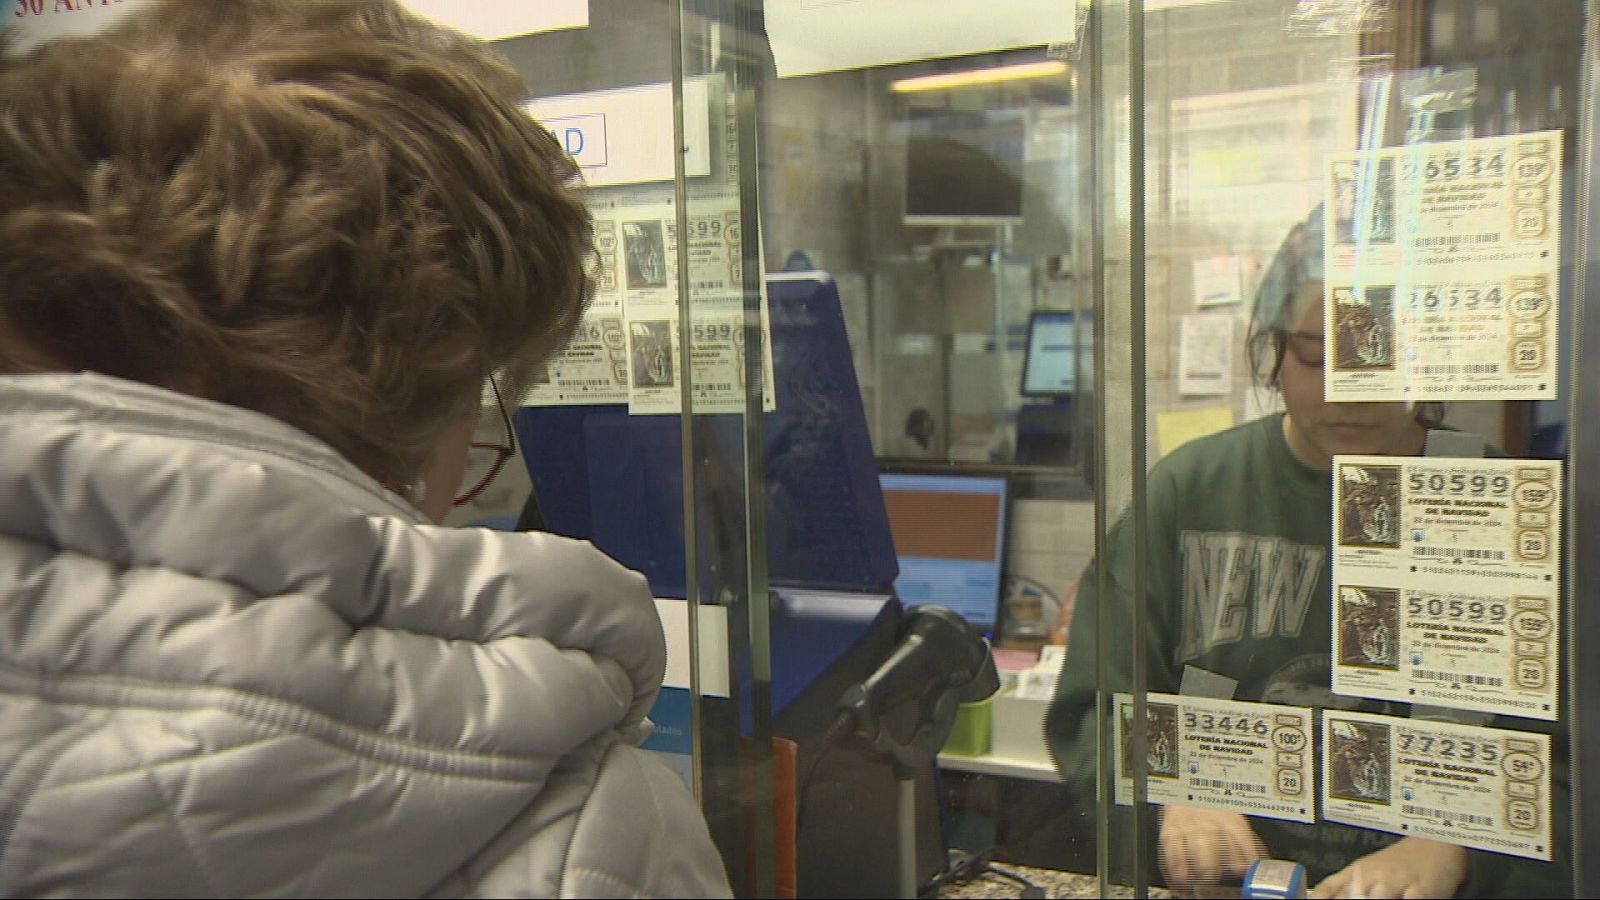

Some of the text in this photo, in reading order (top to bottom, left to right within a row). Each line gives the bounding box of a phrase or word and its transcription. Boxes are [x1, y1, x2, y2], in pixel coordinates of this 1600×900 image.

[1409, 474, 1509, 494] 50599
[1174, 530, 1326, 661] NEW
[1408, 598, 1507, 621] 50599
[1184, 712, 1269, 735] 33446
[1184, 734, 1269, 749] LOTERÍA NACIONAL
[1212, 745, 1254, 755] NAVIDAD
[1399, 734, 1498, 761] 77235
[1282, 777, 1297, 787] 20
